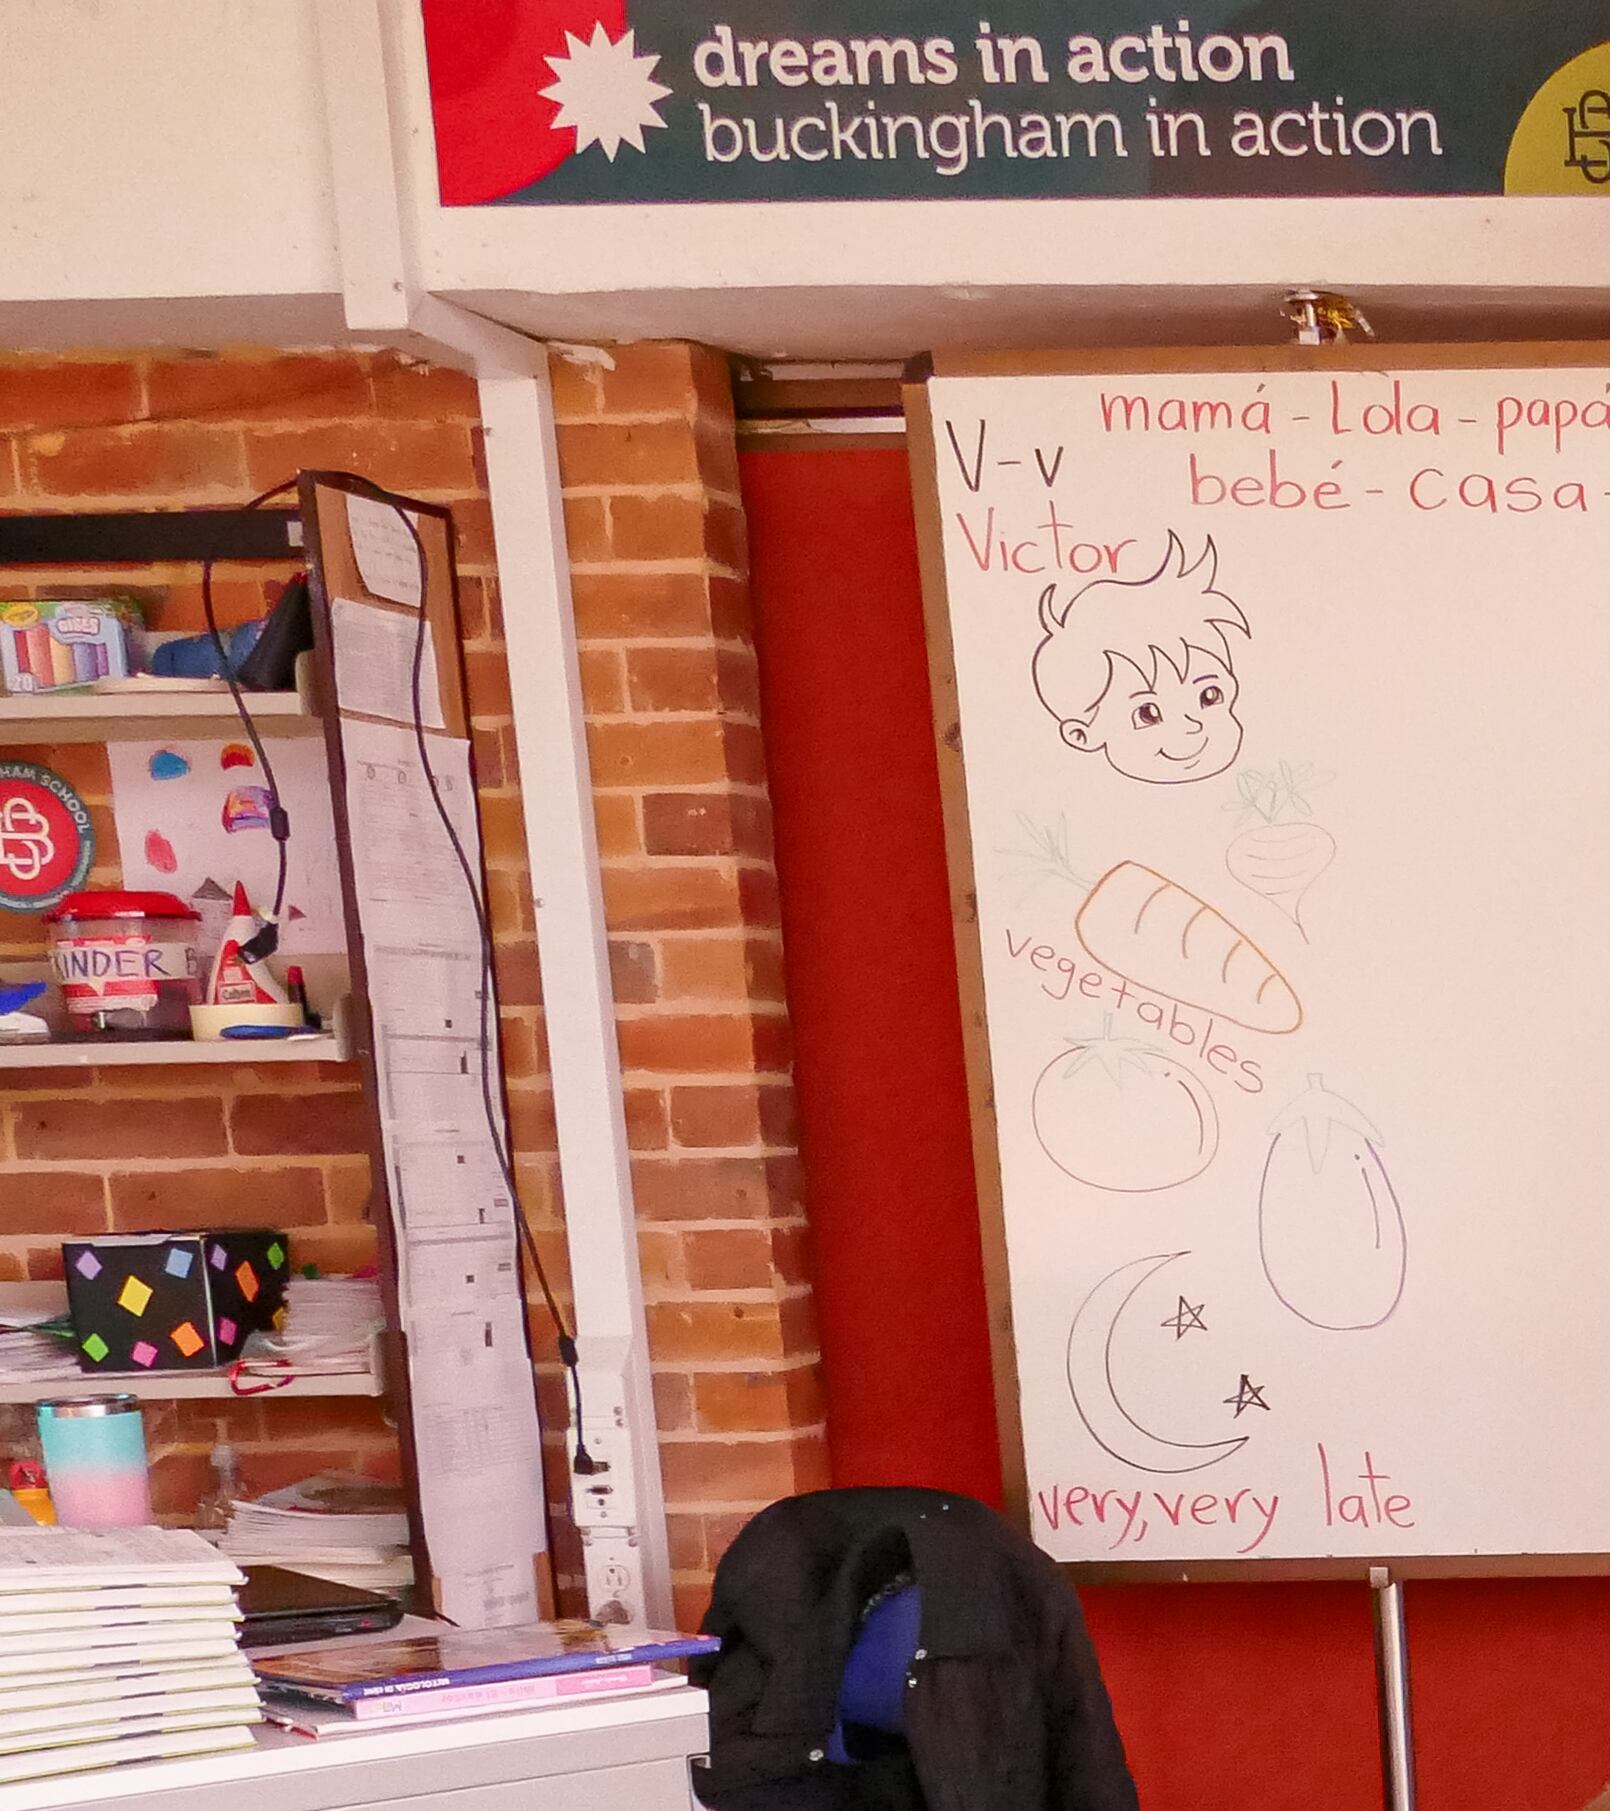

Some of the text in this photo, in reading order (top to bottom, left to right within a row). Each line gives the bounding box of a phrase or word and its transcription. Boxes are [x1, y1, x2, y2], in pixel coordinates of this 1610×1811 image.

[692, 22, 1295, 90] dreams in action
[701, 97, 1444, 176] buckingham in action
[1101, 384, 1271, 433] mamá
[1189, 449, 1351, 508] bebé
[41, 774, 92, 833] SCHOOL
[1006, 929, 1263, 1094] vegetables
[1318, 1443, 1416, 1528] late
